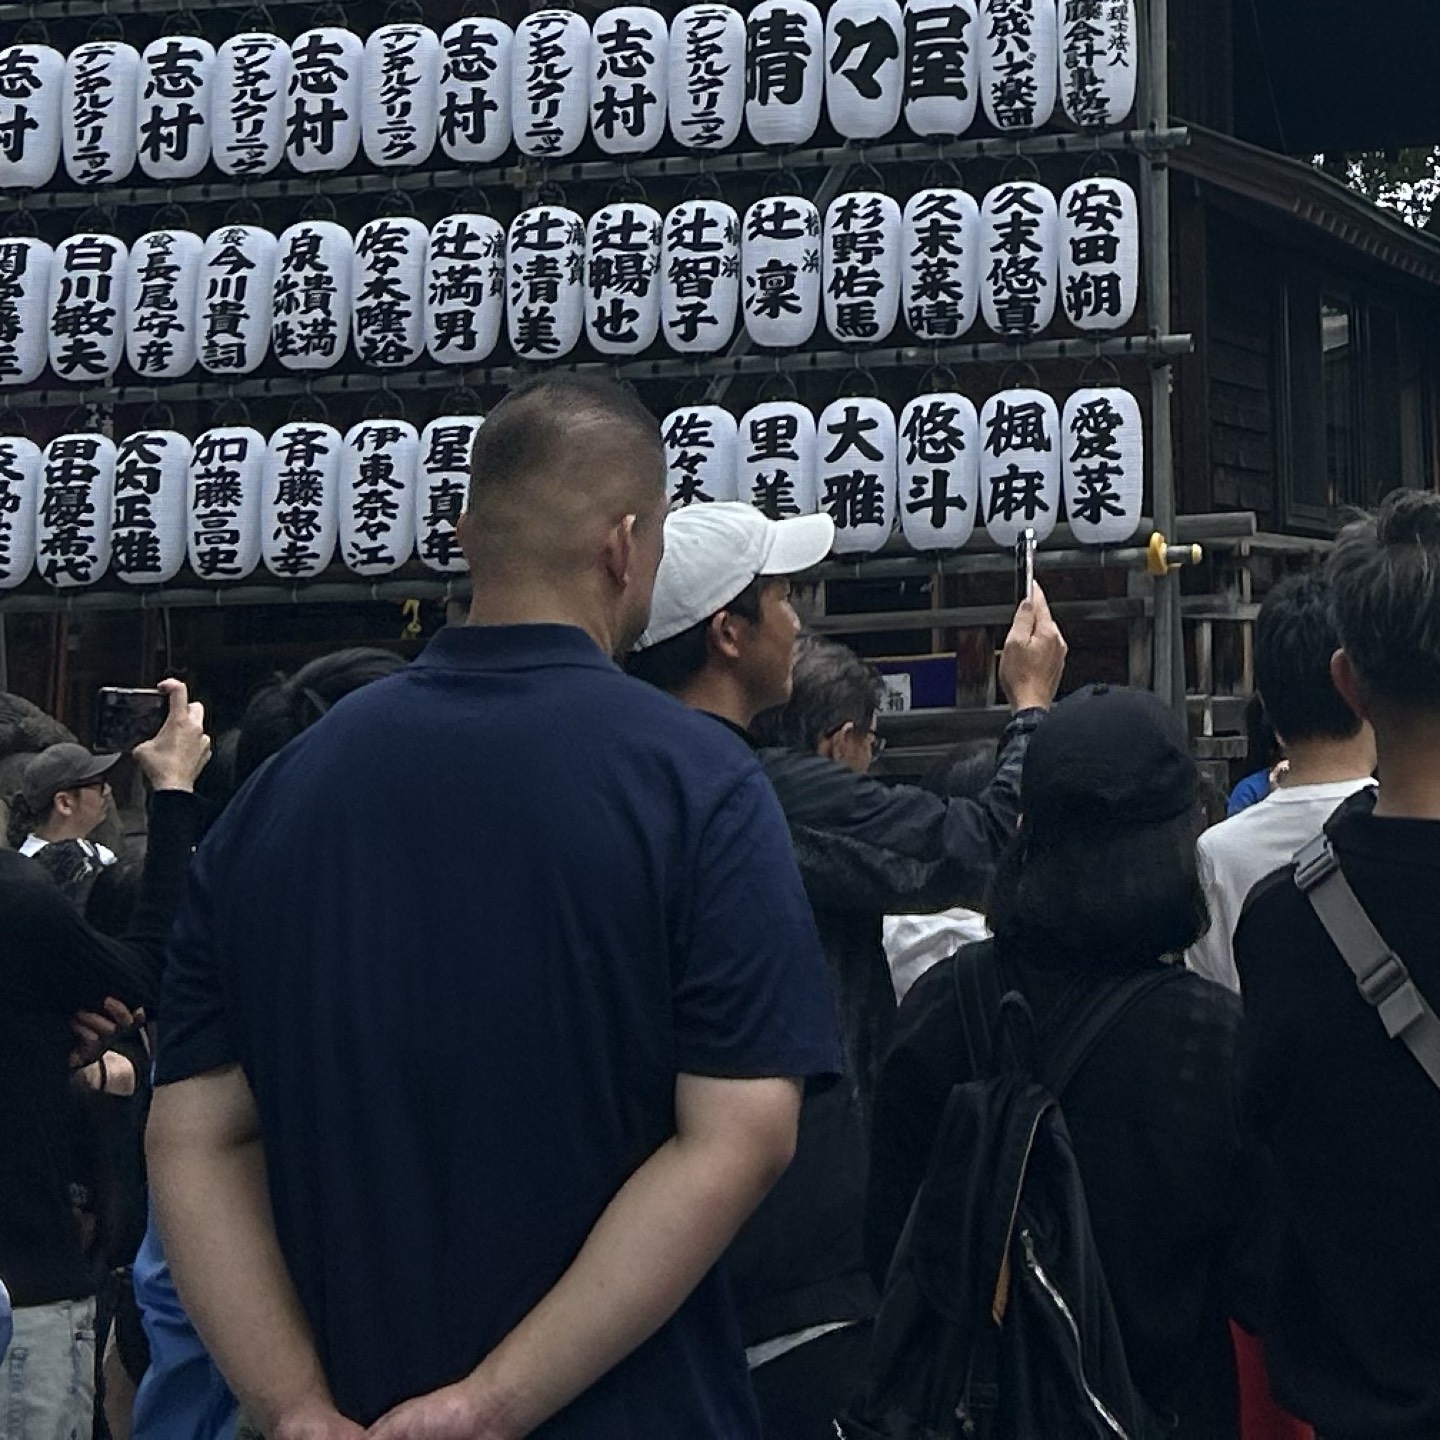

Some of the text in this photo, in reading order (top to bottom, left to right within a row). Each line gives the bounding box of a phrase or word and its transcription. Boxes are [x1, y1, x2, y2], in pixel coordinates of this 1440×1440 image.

[140, 42, 204, 162] 志村
[287, 34, 348, 156] 志村
[377, 27, 422, 161] デンタルクリニック
[440, 24, 498, 146] 志村
[594, 19, 656, 138] 志村
[681, 9, 732, 146] デンタルクリニック
[50, 237, 116, 374] 白川敏夫
[429, 220, 483, 352] 辻満男
[511, 211, 564, 355] 辻清美
[589, 210, 651, 343] 辻暢也
[667, 207, 724, 342] 辻智子
[827, 197, 884, 338] 杉野佑馬
[986, 186, 1047, 335] 久末悠真
[1066, 184, 1123, 321] 安田朔
[190, 434, 249, 576] 加藤高史
[663, 413, 715, 509] 佐々木
[746, 414, 801, 521] 里美
[821, 406, 885, 529] 大雅
[902, 401, 967, 528] 悠斗
[984, 400, 1052, 524] 楓麻
[1070, 397, 1127, 524] 愛菜
